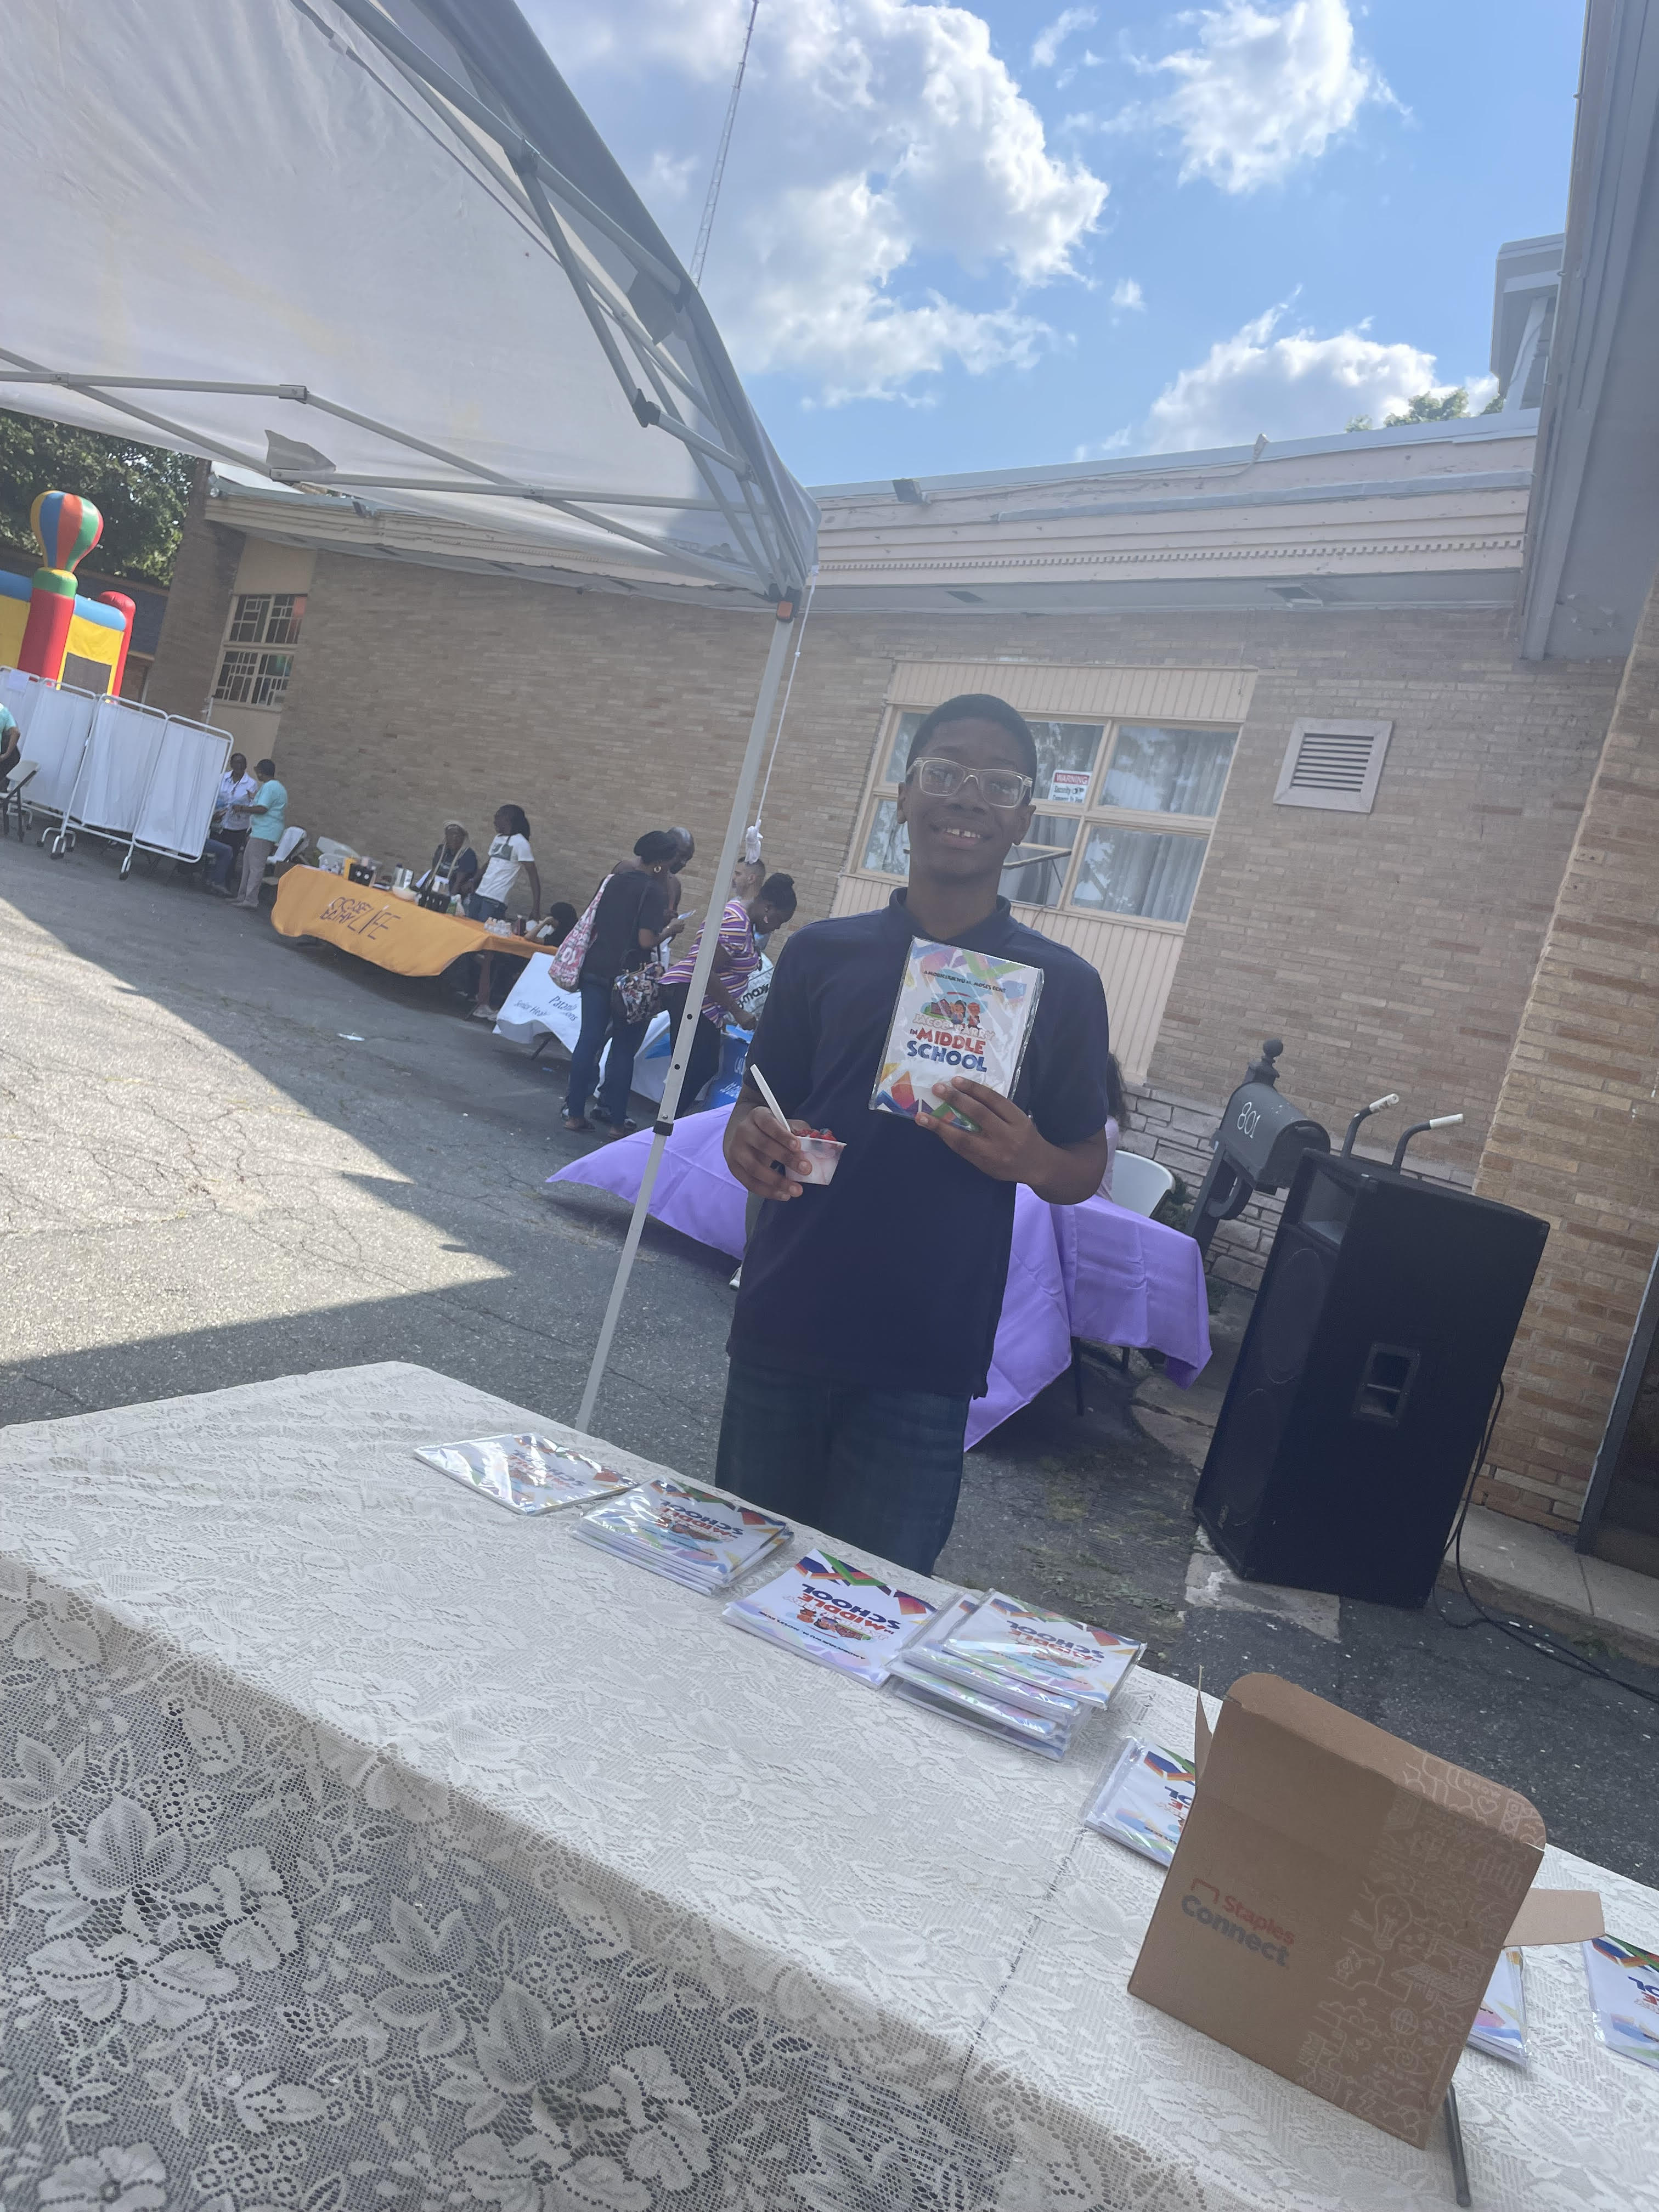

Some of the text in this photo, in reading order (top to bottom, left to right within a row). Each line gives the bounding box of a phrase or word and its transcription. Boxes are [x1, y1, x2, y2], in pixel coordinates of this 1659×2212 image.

[1056, 774, 1088, 785] WARNING
[907, 1040, 987, 1073] SCHOOL
[916, 1028, 986, 1055] MIDDLE
[1237, 1102, 1261, 1138] 801
[797, 1593, 887, 1630] MIDDLE
[802, 1583, 901, 1629] SCHOOL
[1007, 1620, 1104, 1658] SCHOOL
[1009, 1628, 1093, 1660] MIDDLE
[1182, 1895, 1289, 1966] Connect
[1222, 1895, 1295, 1945] Staples
